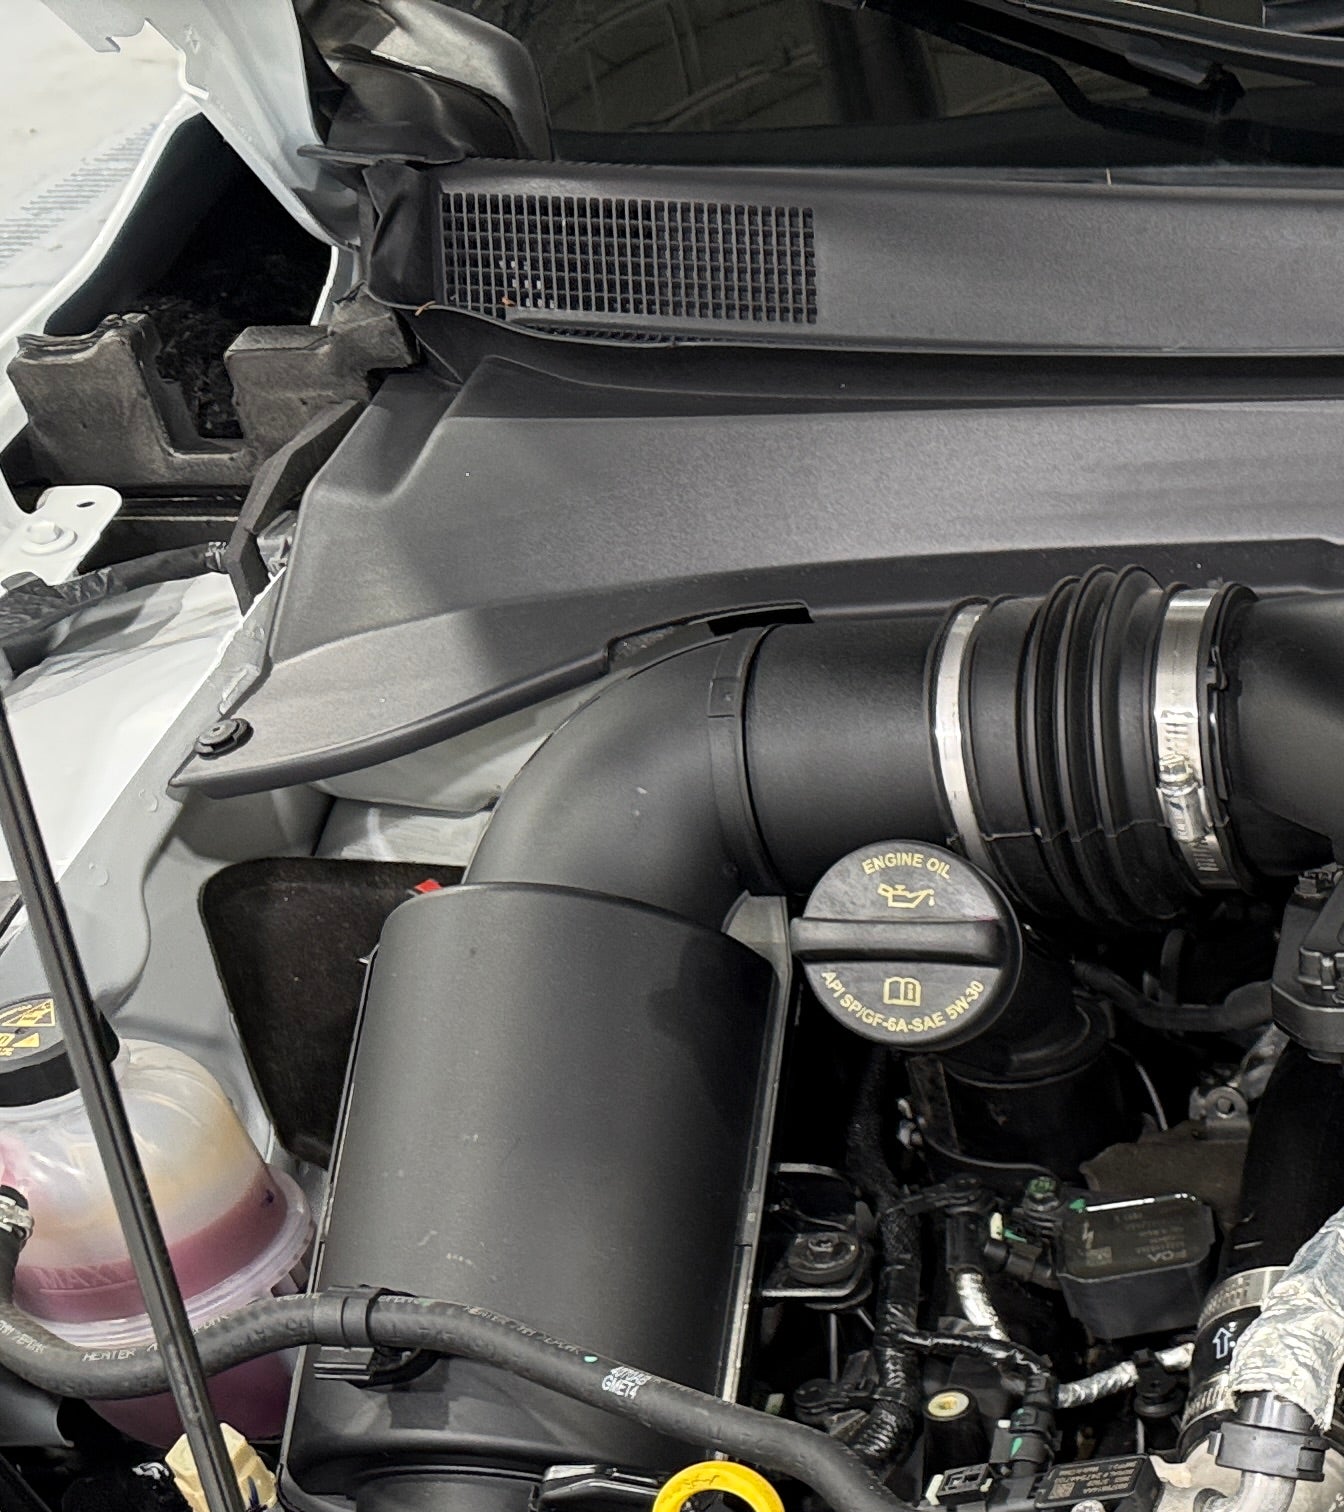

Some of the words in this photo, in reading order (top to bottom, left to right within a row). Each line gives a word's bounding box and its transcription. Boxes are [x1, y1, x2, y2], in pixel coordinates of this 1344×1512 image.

[862, 853, 924, 875] ENGINE
[926, 857, 951, 879] OIL
[821, 971, 845, 998] API
[945, 980, 985, 1020] 5W-30
[82, 1350, 136, 1362] HEATER
